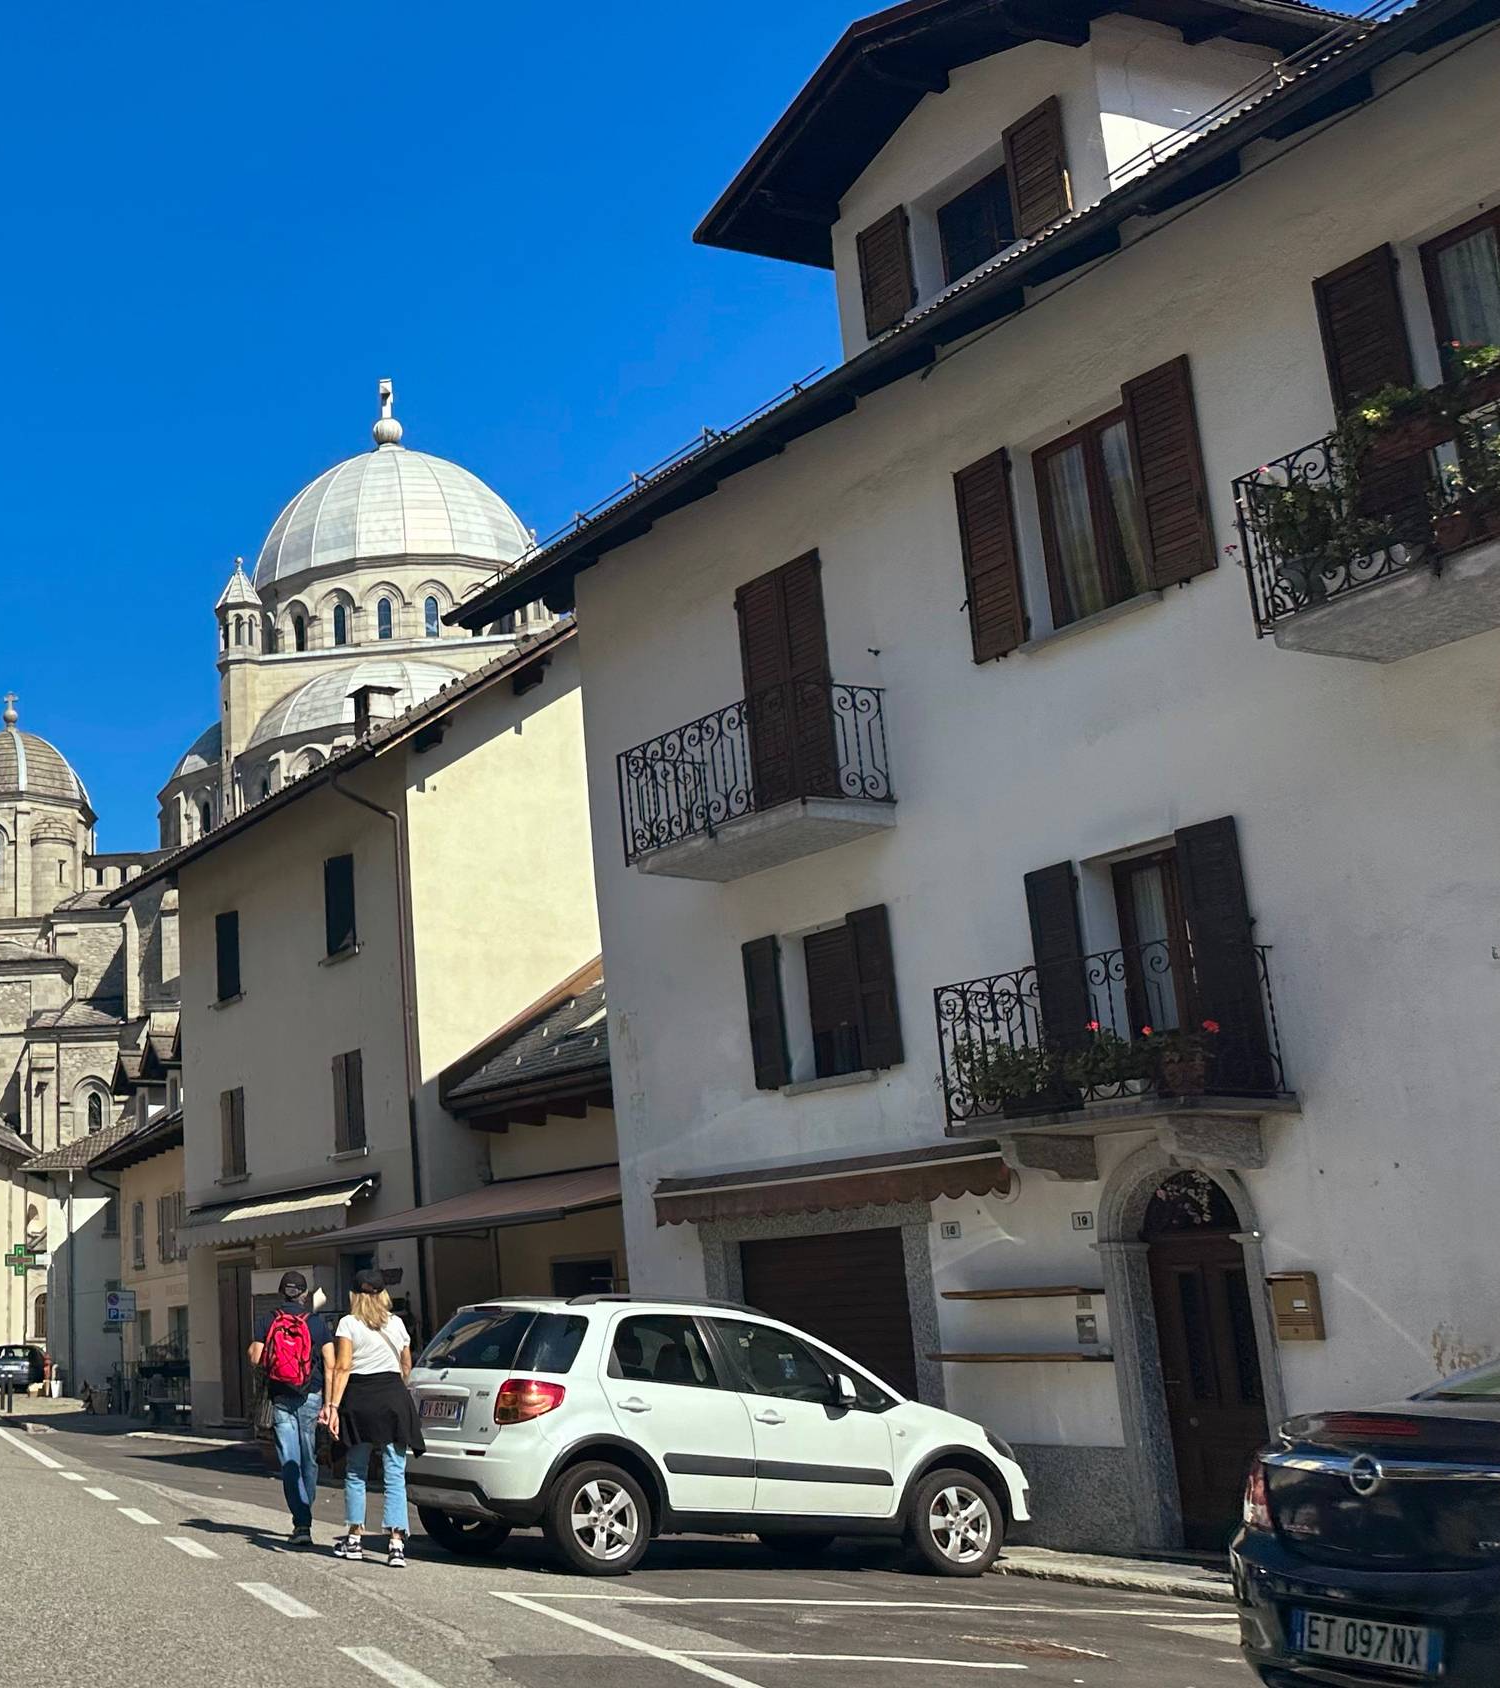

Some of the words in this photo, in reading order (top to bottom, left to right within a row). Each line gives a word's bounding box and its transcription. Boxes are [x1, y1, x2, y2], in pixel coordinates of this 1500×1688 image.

[1077, 1215, 1088, 1226] 19
[1308, 1615, 1335, 1651] ET
[1344, 1621, 1421, 1665] 097NX
